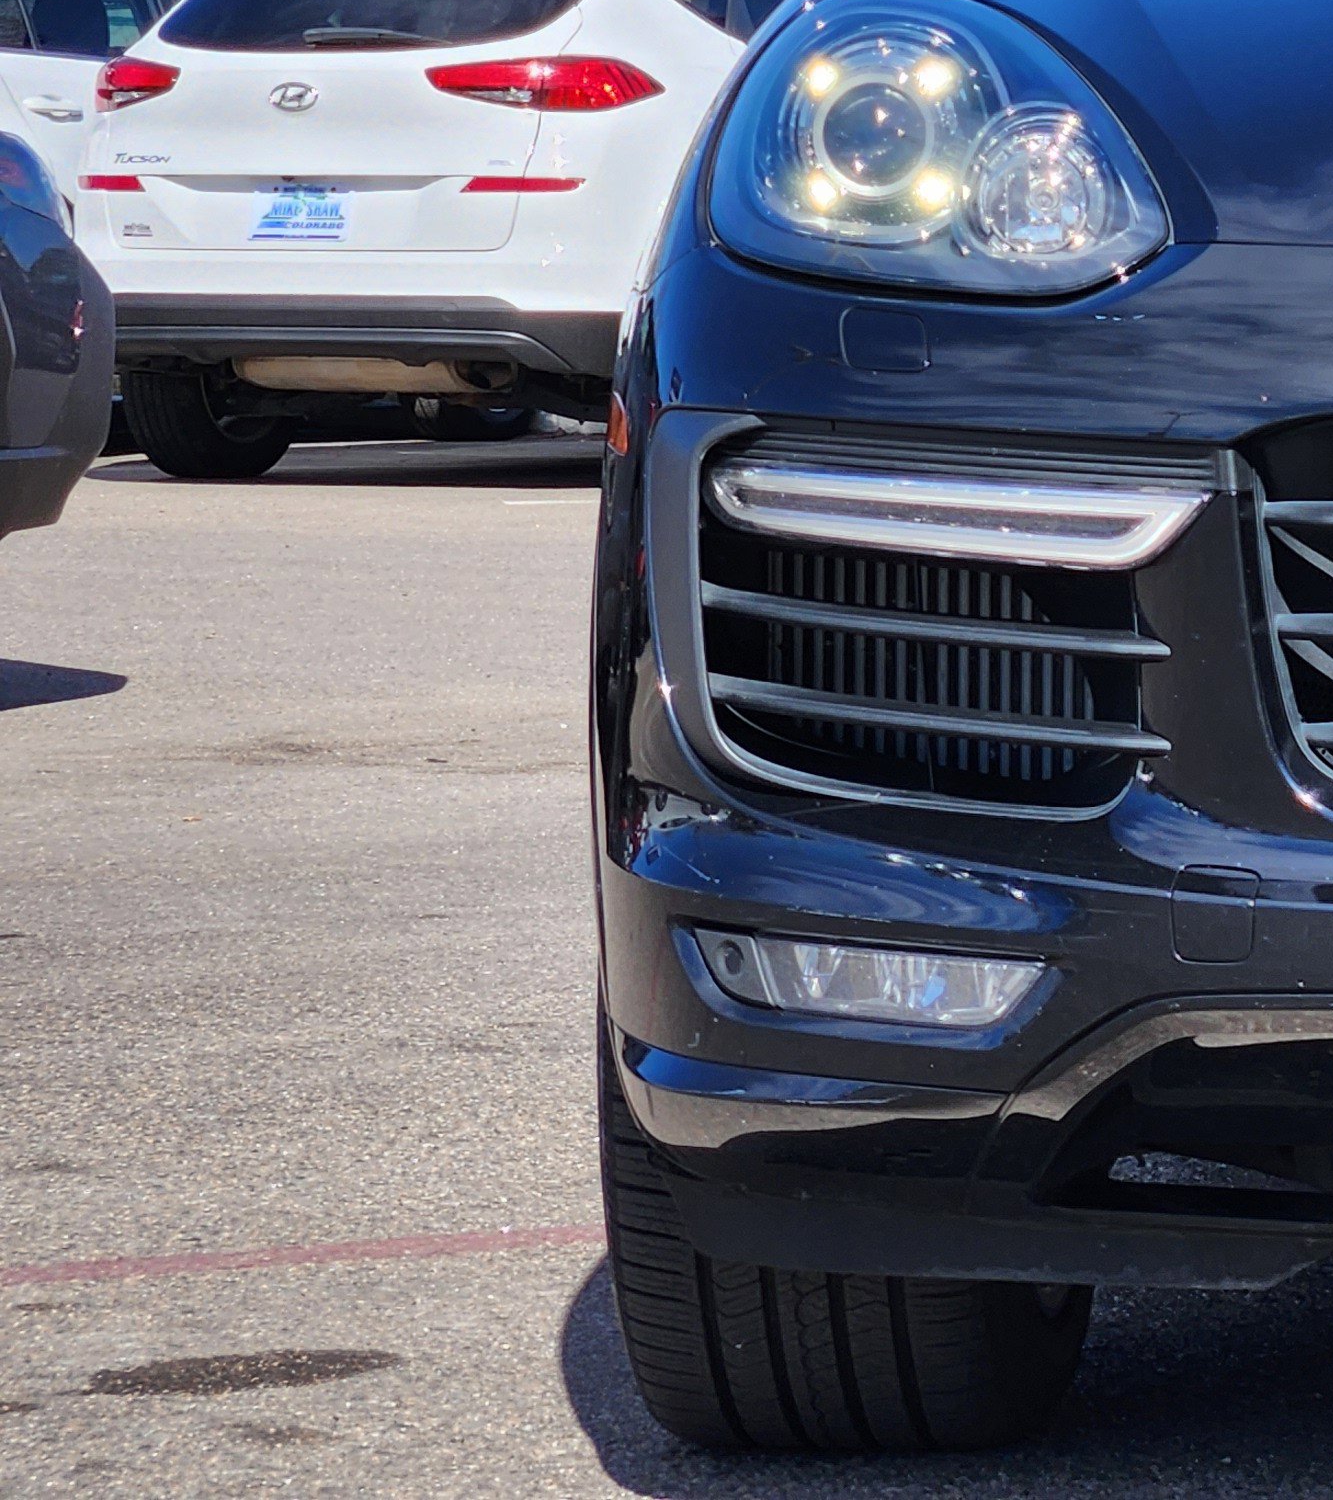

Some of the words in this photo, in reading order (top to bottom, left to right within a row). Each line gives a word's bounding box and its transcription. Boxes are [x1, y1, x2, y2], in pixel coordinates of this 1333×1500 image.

[271, 201, 303, 216] MIKE
[305, 201, 341, 217] SHAW
[286, 221, 345, 230] COLORADO
